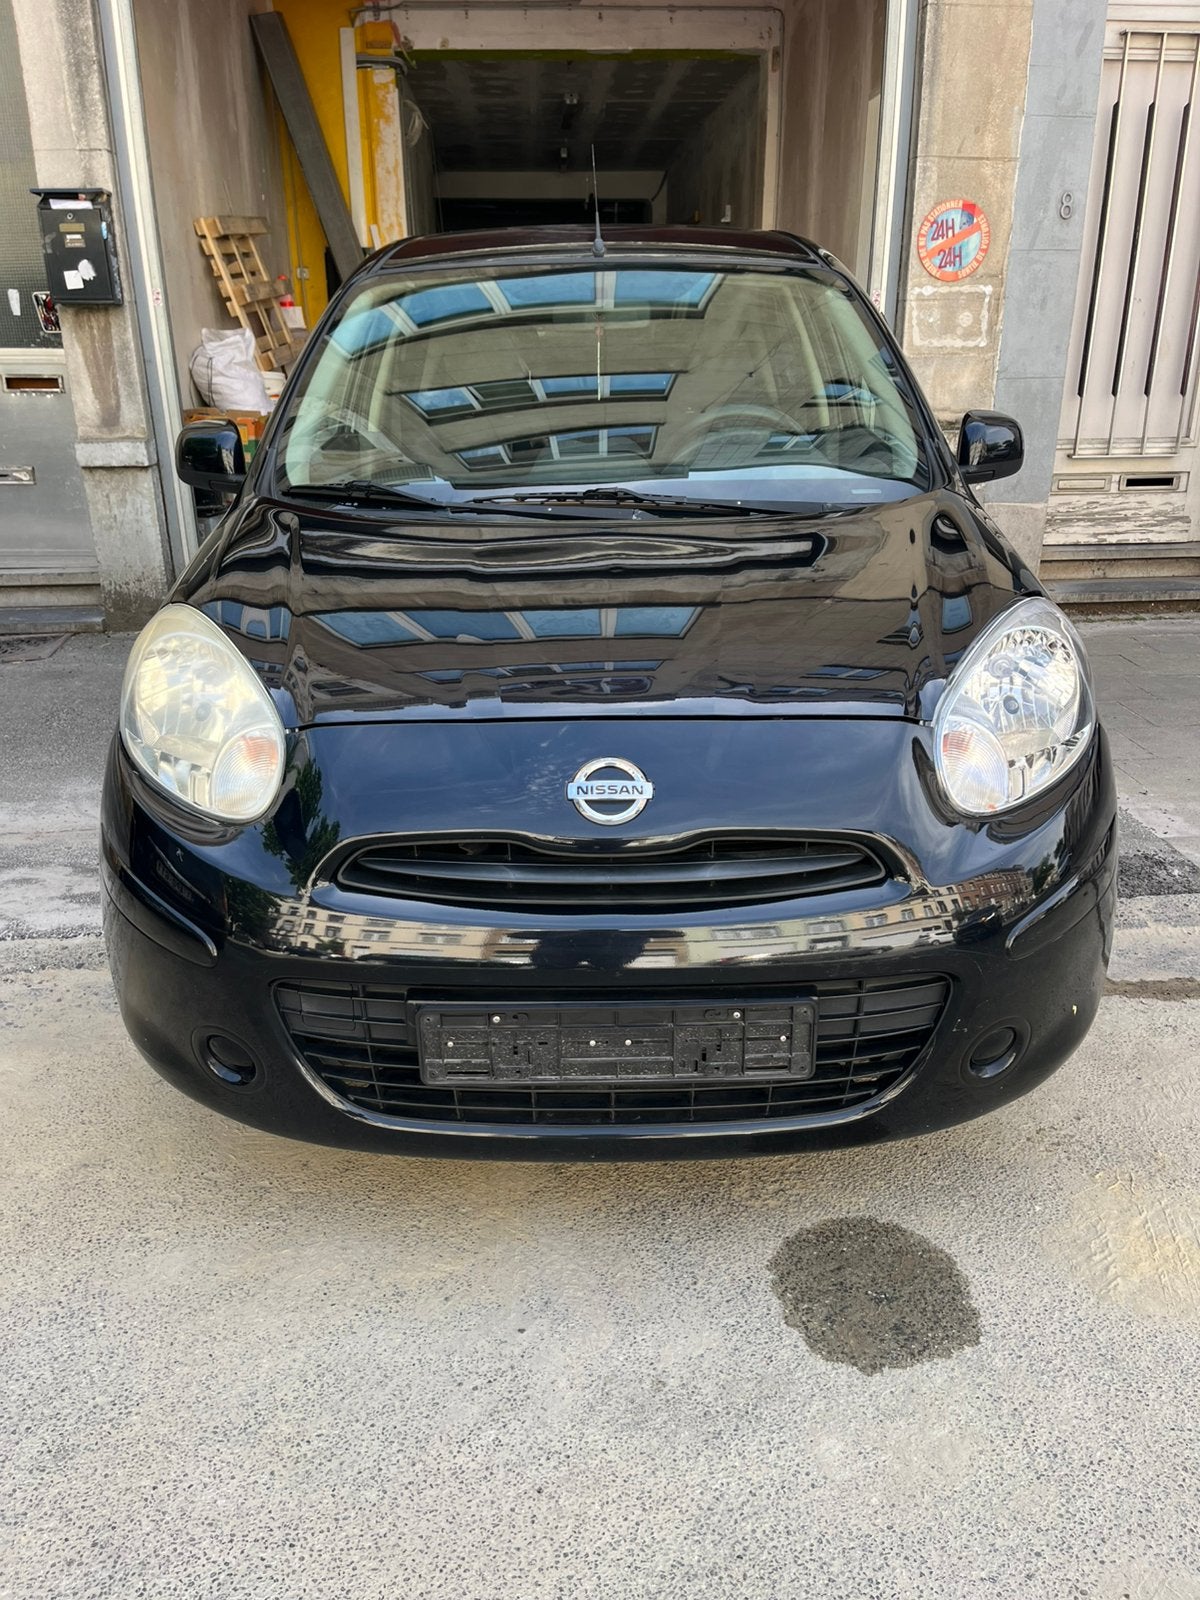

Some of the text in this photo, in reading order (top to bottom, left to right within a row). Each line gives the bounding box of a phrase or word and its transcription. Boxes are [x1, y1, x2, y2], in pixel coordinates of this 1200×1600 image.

[920, 220, 930, 234] PAS
[927, 199, 963, 221] STATIONNER
[1059, 191, 1074, 220] 8
[931, 218, 955, 241] 24H
[938, 246, 962, 268] 24H
[957, 213, 989, 279] SORTIE DE VOITURES
[577, 785, 643, 795] NISSAN
